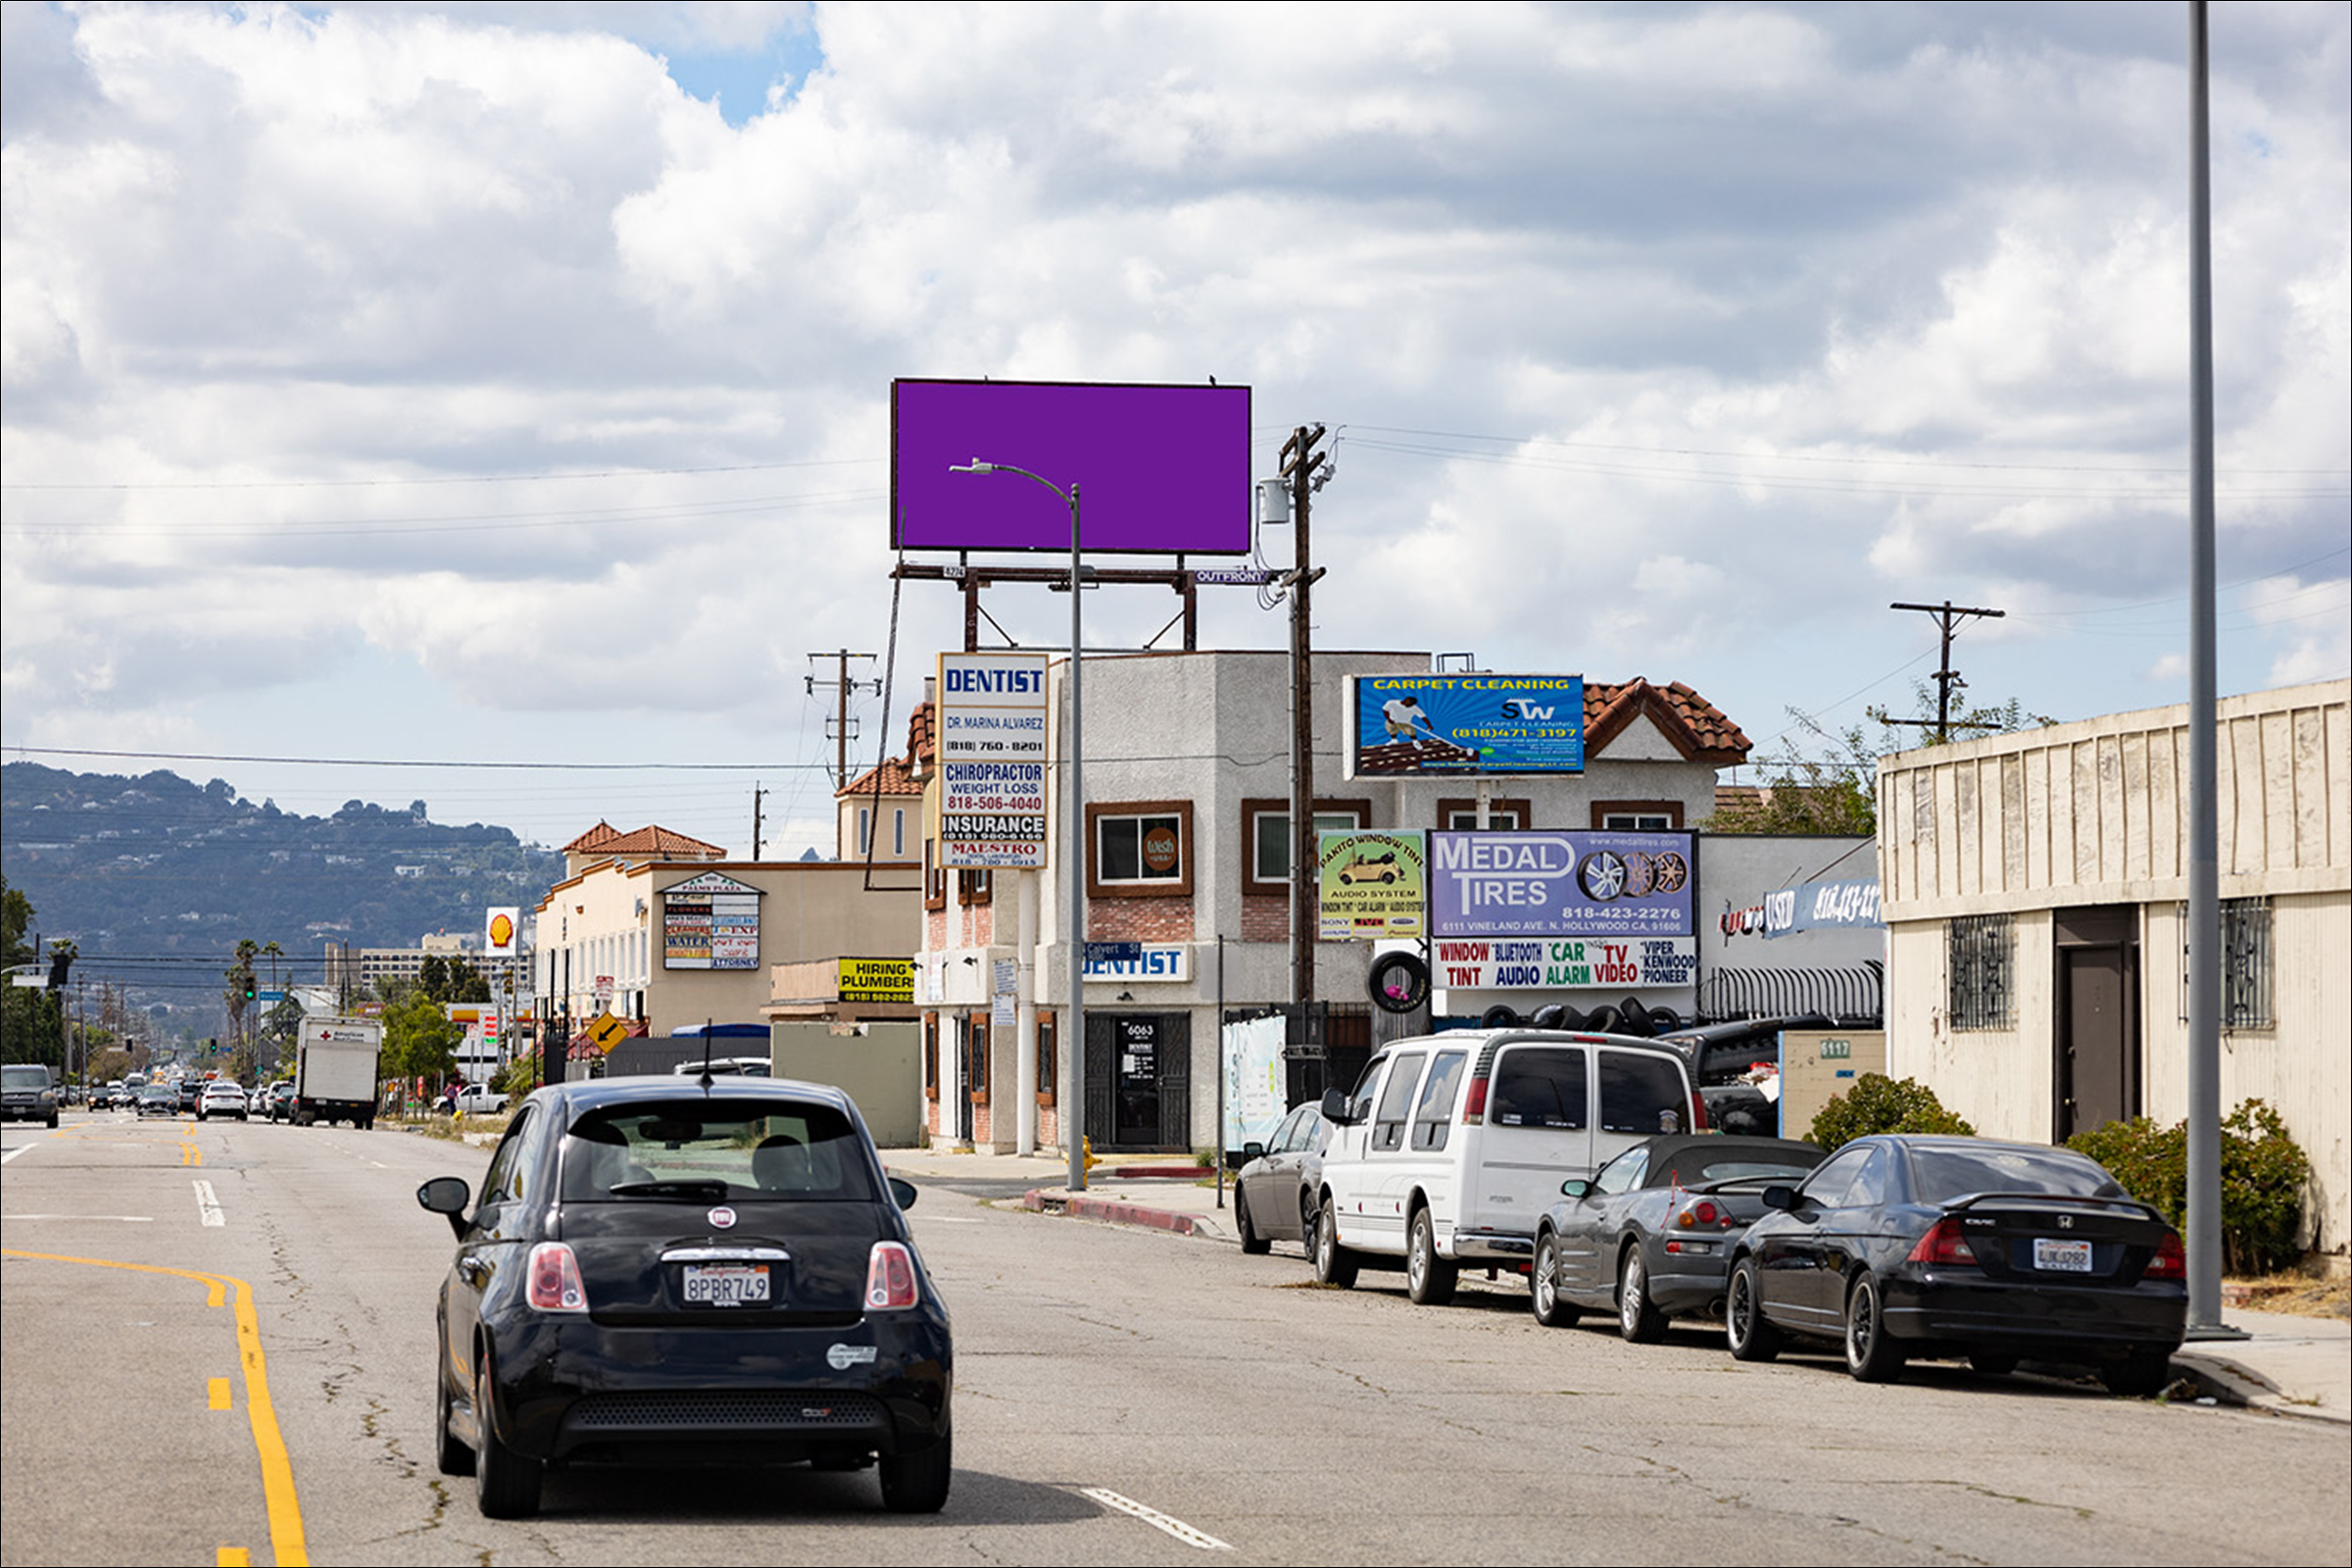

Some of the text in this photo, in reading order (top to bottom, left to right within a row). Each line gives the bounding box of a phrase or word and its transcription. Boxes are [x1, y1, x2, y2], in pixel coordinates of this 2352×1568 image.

[947, 669, 1043, 693] DENTIST
[1373, 679, 1569, 691] CARPET CLEANING
[948, 716, 1044, 730] DR. MARINA ALVAREZ
[1452, 728, 1577, 739] (818)471-3197
[947, 741, 976, 753] (818)
[979, 741, 1004, 752] 760
[1011, 741, 1043, 752] 8201
[946, 764, 1043, 781] CHIROPRACTOR
[951, 783, 1038, 795] WEIGHT LOSS
[948, 796, 1043, 810] 818-506-4040
[943, 816, 1045, 833] INSURANCE
[1589, 838, 1680, 847] www.medaltires.com
[952, 844, 1038, 856] MAESTRO
[1320, 834, 1425, 869] PAKITO WINDOW TINT
[1436, 837, 1558, 870] MEDAL
[1451, 872, 1547, 915] TIRES
[1562, 907, 1681, 919] 818-423-2276
[665, 926, 710, 936] CLEANERS
[1442, 922, 1465, 931] 6111
[1468, 921, 1521, 931] VINELAND
[1523, 921, 1547, 931] AVE.
[1549, 921, 1560, 931] N.
[1562, 921, 1629, 931] HOLLYWOOD
[667, 937, 710, 947] WATER
[1644, 941, 1674, 955] VIPER
[1087, 944, 1139, 956] Calvert St
[1440, 943, 1490, 962] WINDOW
[1494, 943, 1543, 962] BLUETOOTH
[1550, 942, 1586, 962] CAR
[1603, 945, 1629, 964] TV
[712, 958, 758, 967] ATTORNEY
[1644, 955, 1695, 968] KENWOOD
[857, 963, 906, 976] HIRING
[1495, 965, 1541, 986] AUDIO
[1545, 965, 1591, 985] ALARM
[1594, 963, 1639, 983] VIDEO
[1644, 969, 1688, 983] PIONEER
[1446, 967, 1482, 987] TINT
[1128, 1025, 1153, 1036] 6063
[688, 1278, 766, 1299] 8PBR749
